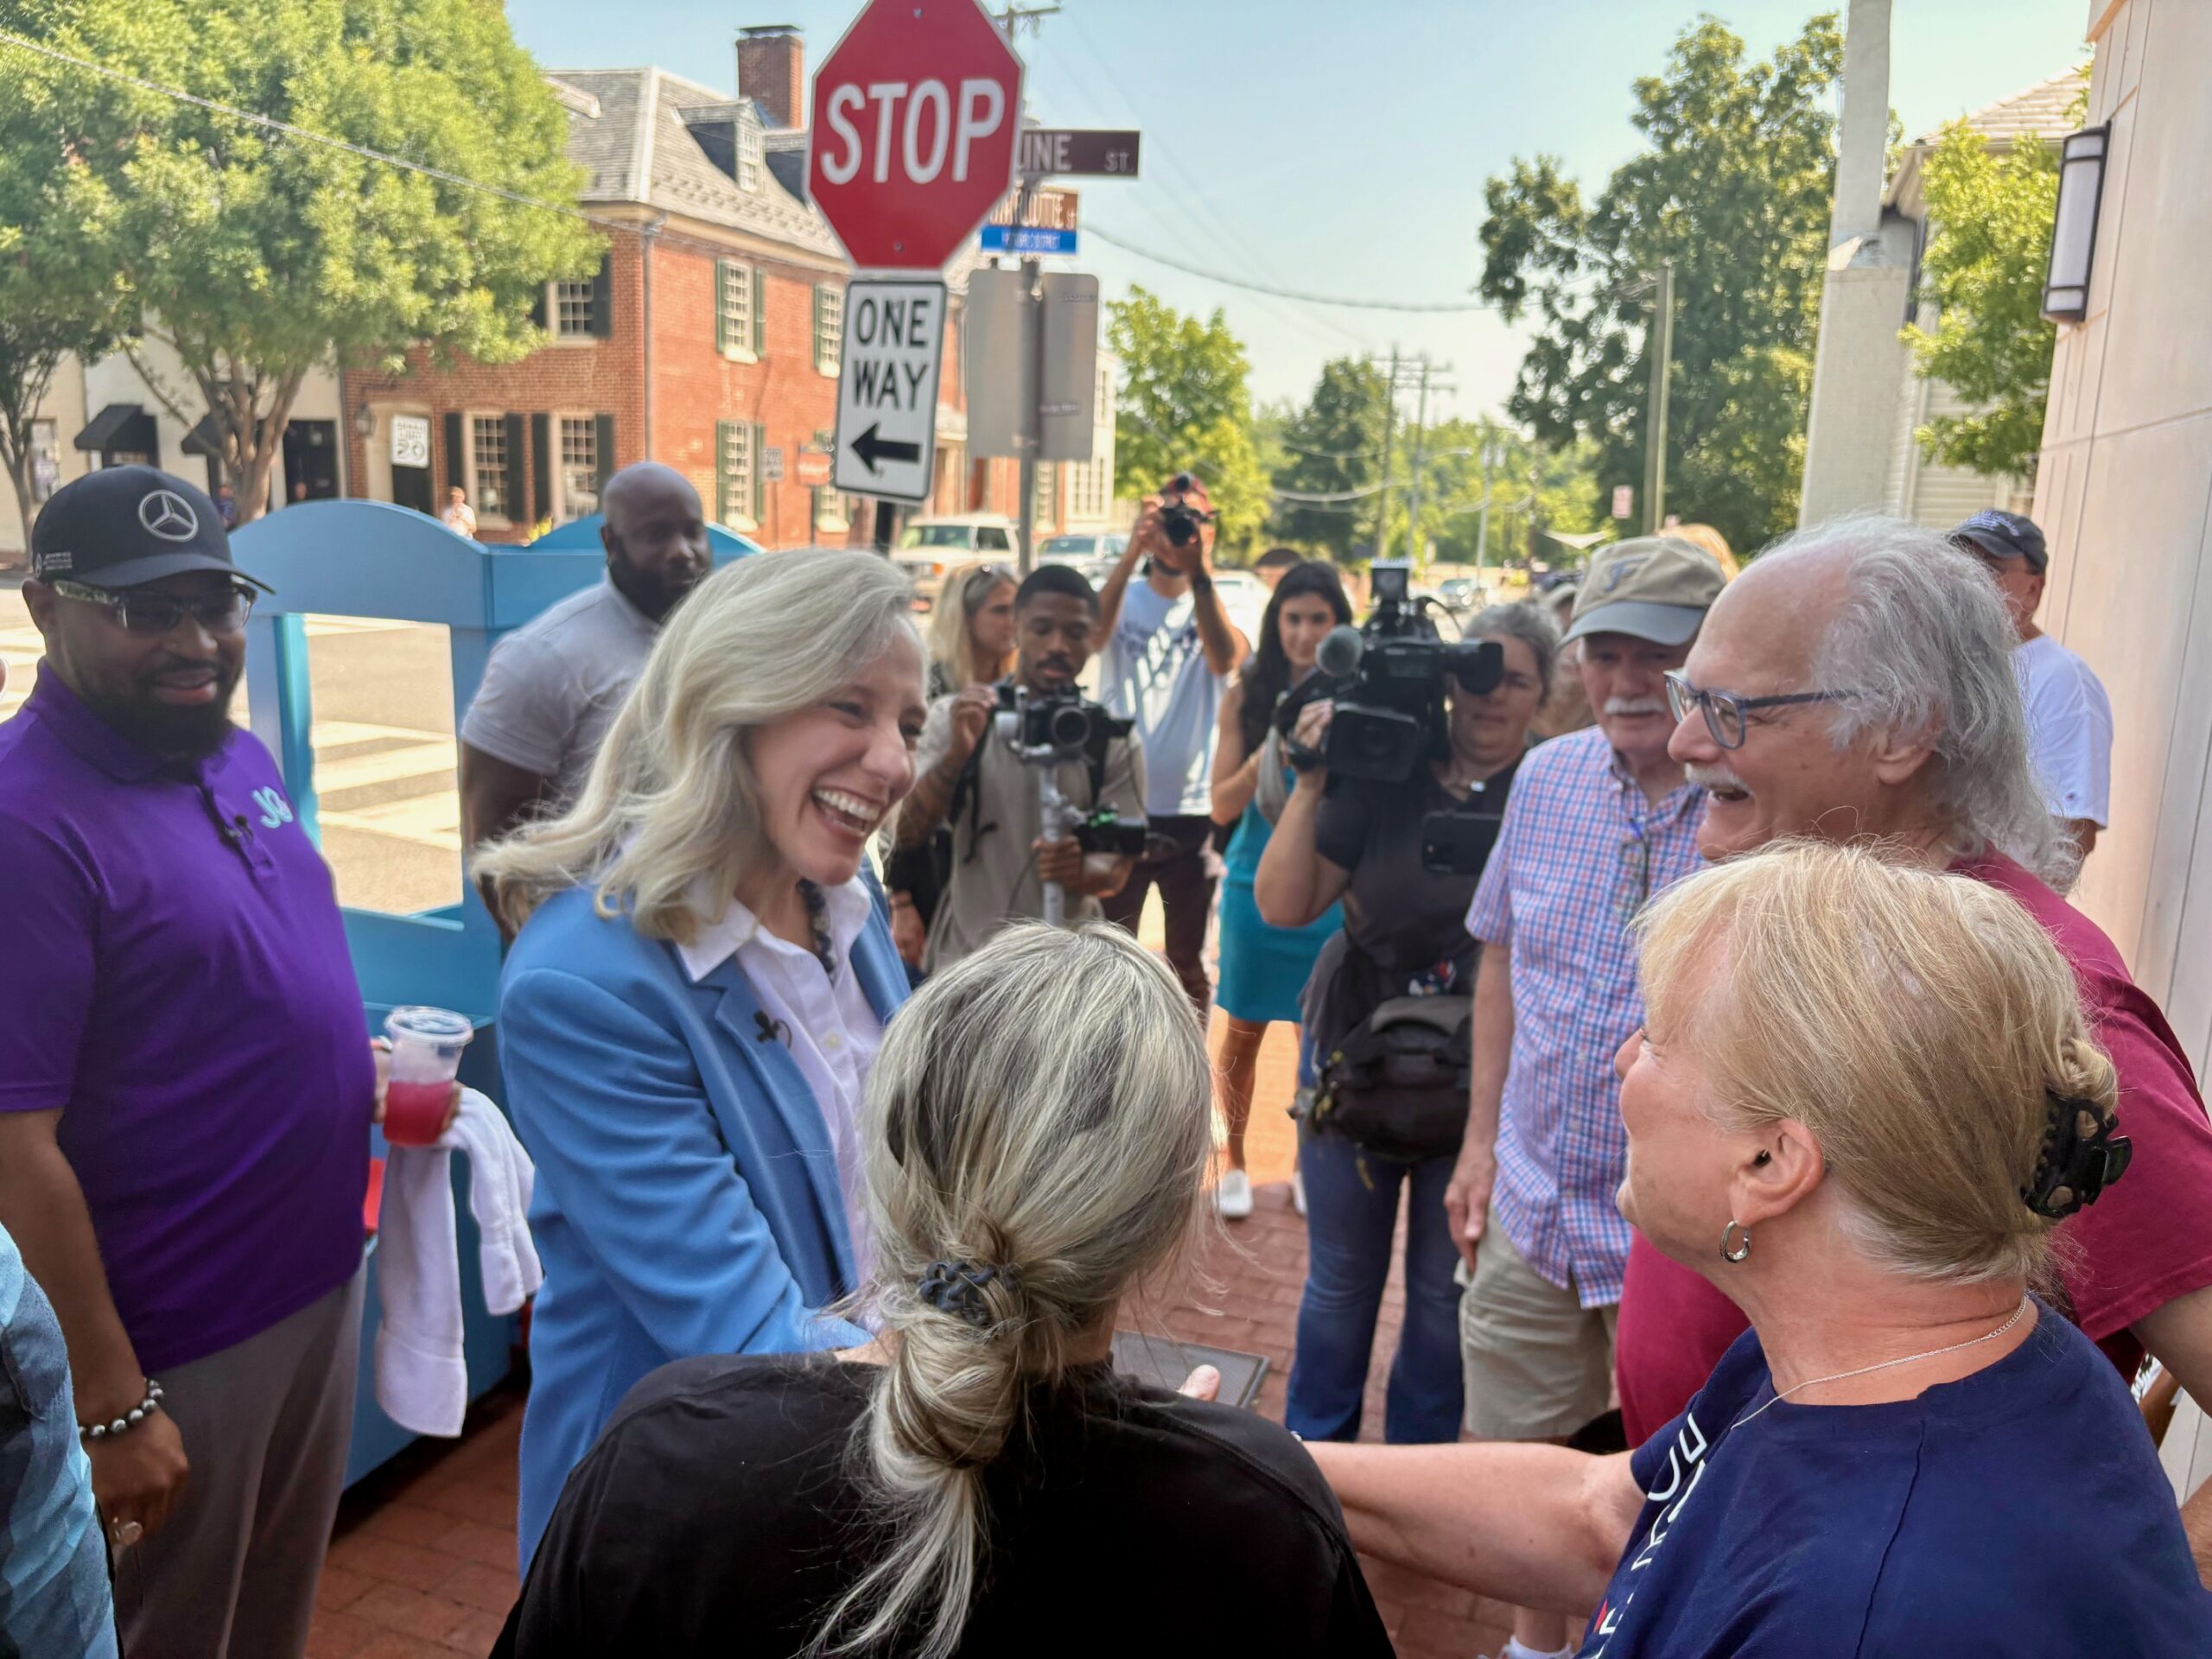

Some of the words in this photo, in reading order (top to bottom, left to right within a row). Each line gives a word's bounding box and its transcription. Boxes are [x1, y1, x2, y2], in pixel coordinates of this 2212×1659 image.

[822, 79, 1005, 184] STOP
[1019, 132, 1071, 171] INE
[856, 298, 931, 347] ONE
[852, 358, 930, 411] WAY
